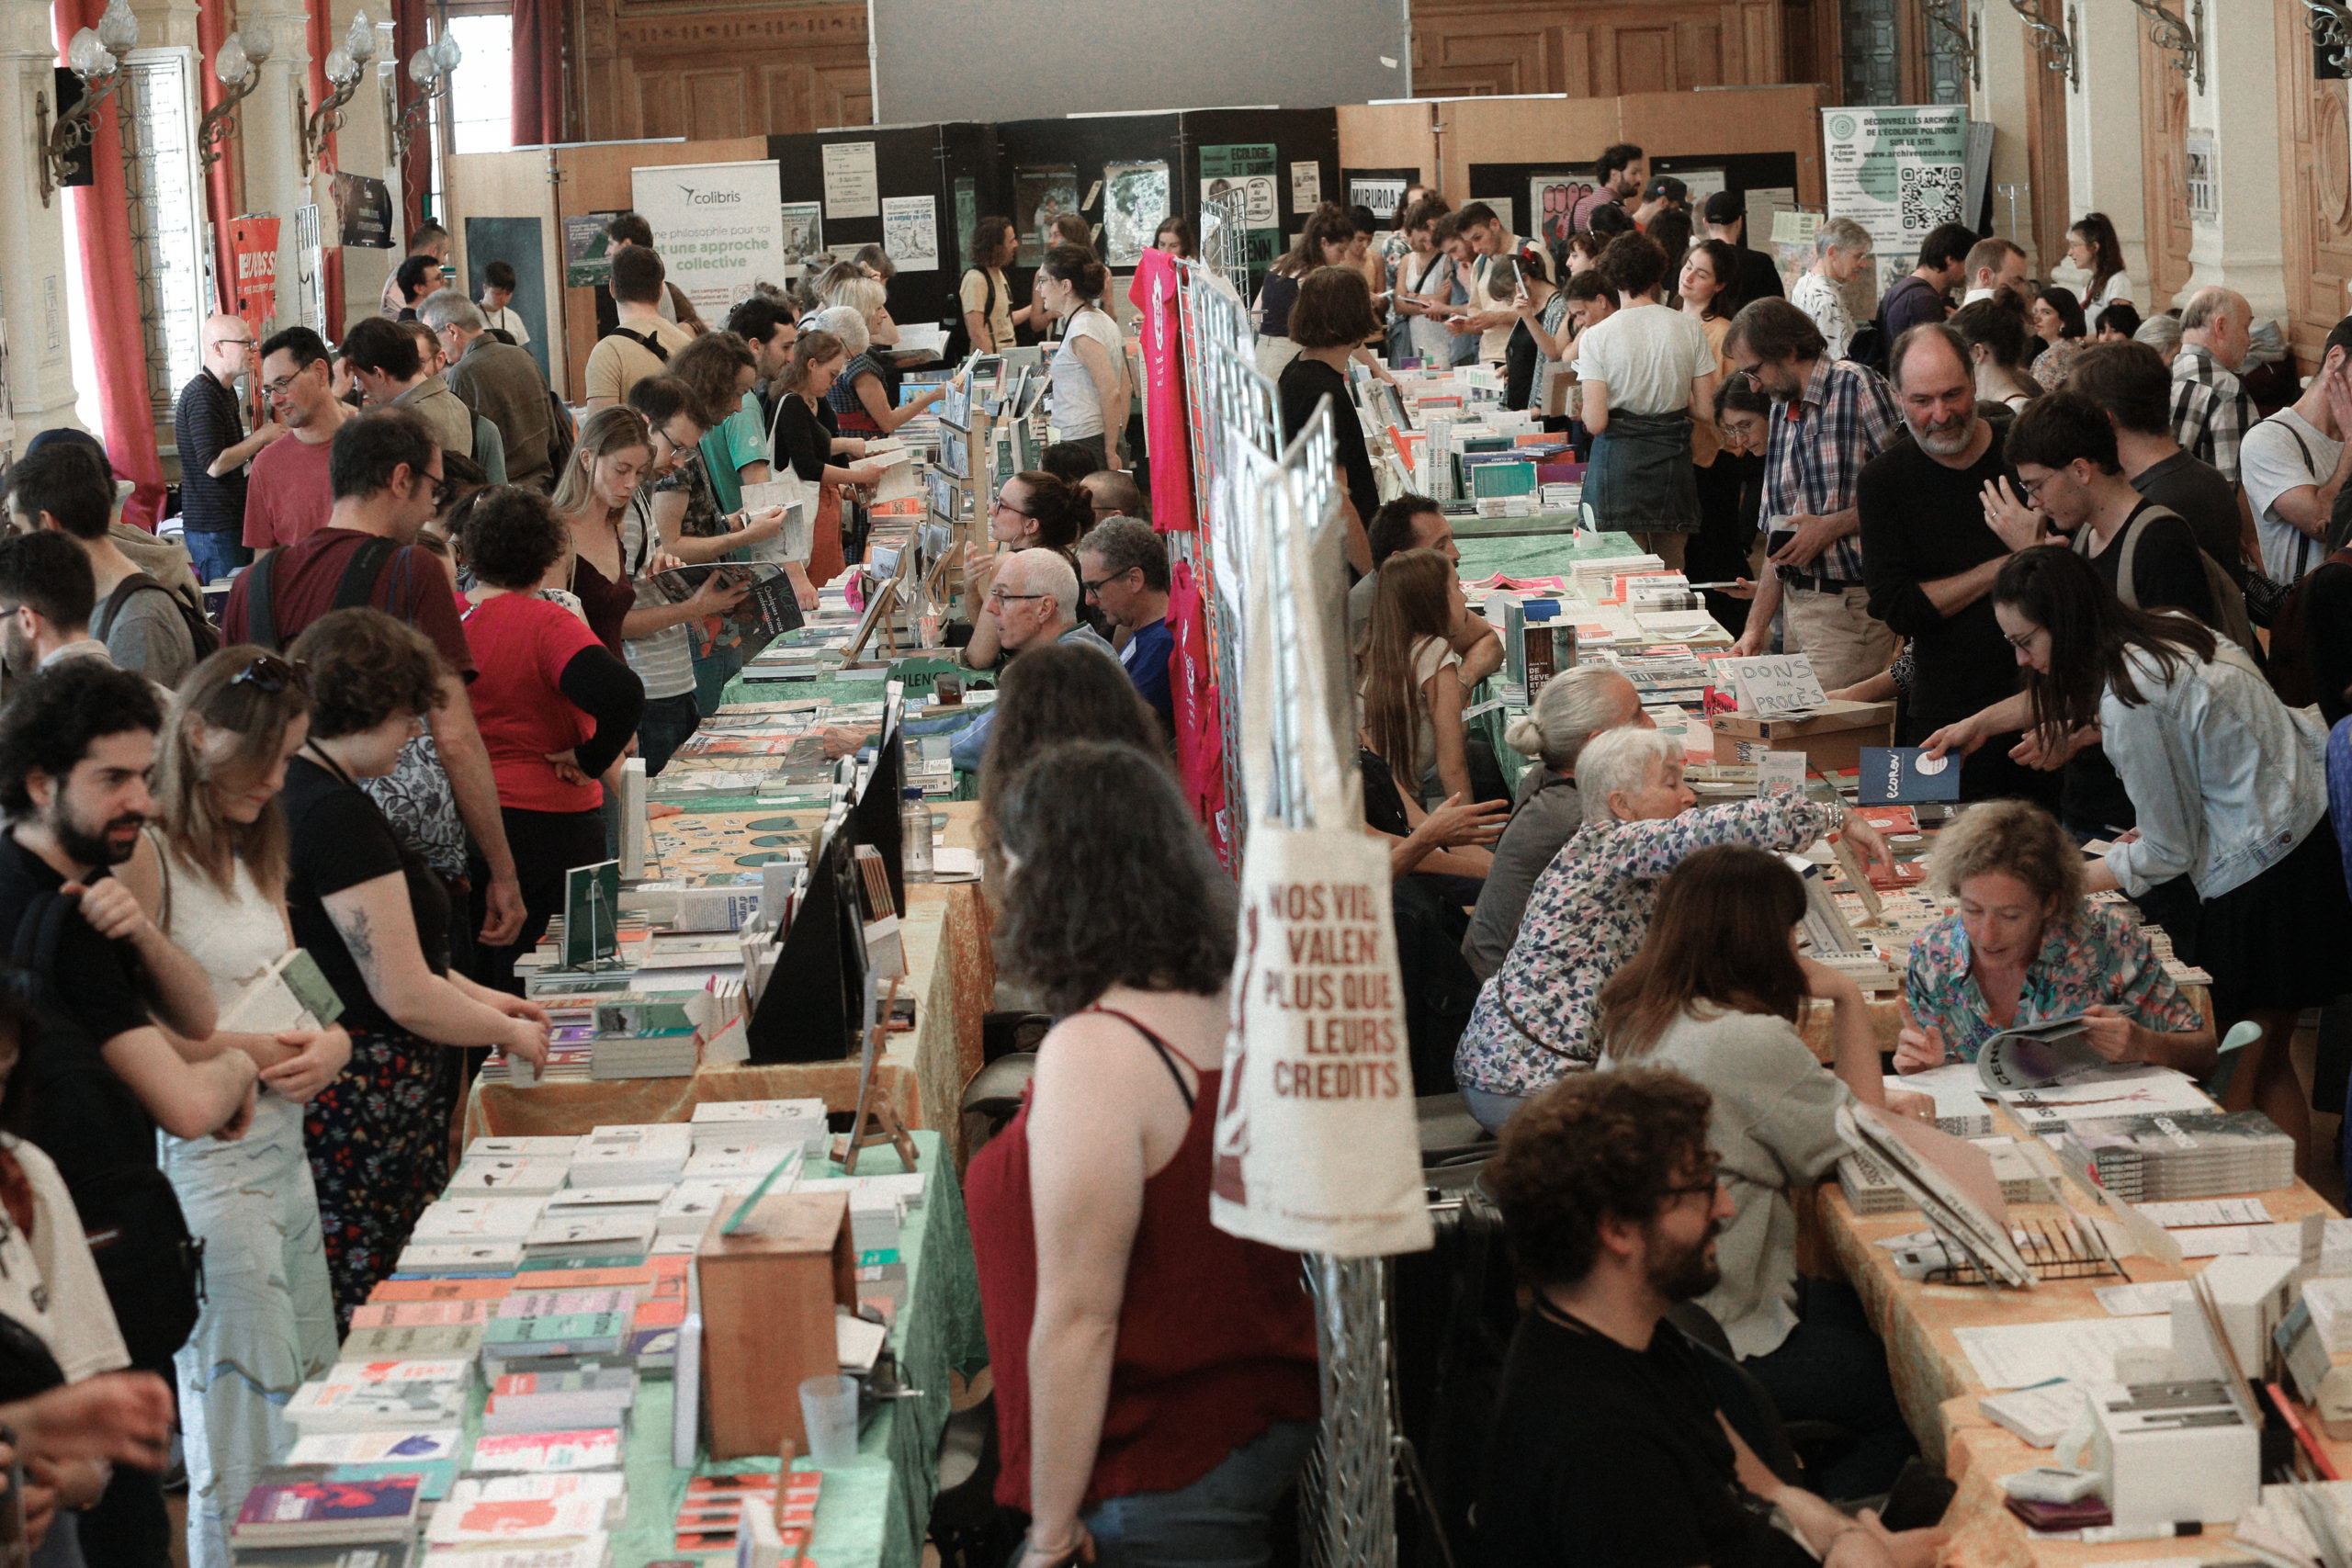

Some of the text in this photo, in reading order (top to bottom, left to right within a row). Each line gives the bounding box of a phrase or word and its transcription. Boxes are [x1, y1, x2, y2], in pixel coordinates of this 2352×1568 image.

[1864, 117, 1906, 126] DÉCOUVREZ
[1924, 116, 1960, 124] ARCHIVES
[1920, 127, 1958, 135] POLITIQUE
[1231, 146, 1272, 161] ECOLOGIE
[1232, 164, 1242, 175] ET
[695, 191, 741, 204] colibris
[653, 230, 667, 240] ne
[670, 226, 728, 240] philosophie
[730, 225, 753, 236] pour
[670, 243, 697, 255] une
[700, 238, 770, 254] approche
[1247, 238, 1272, 262] ENN
[676, 256, 747, 271] collective
[764, 585, 785, 633] Quelques voix
[1741, 659, 1814, 680] DONS
[1756, 686, 1827, 711] PROCÈS
[1268, 884, 1377, 921] NOS VIE
[1287, 926, 1381, 965] VALEN
[1264, 970, 1393, 1011] PLUS QUE
[1306, 1018, 1397, 1056] LEURS
[1273, 1061, 1400, 1099] CREDITS
[2030, 1120, 2065, 1129] CENSORE
[2098, 1153, 2143, 1164] CENSORED
[2099, 1164, 2143, 1174] CENSORED
